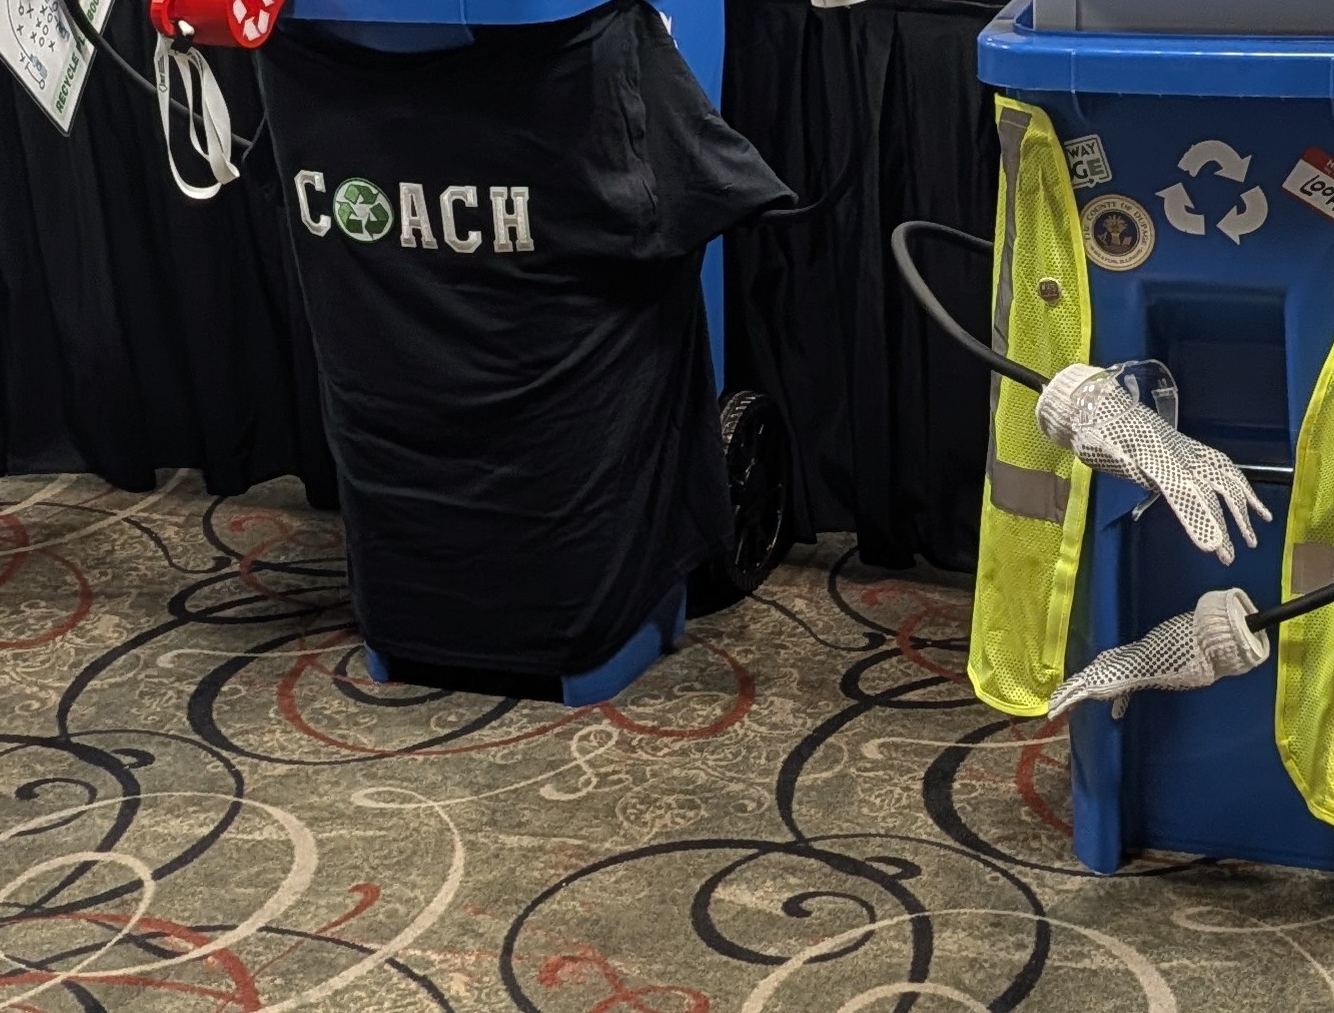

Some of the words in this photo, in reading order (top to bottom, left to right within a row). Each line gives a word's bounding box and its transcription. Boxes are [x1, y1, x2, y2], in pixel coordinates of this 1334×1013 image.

[55, 52, 81, 115] RECYCLE
[1087, 200, 1117, 221] COUNTY
[1120, 201, 1133, 211] OF
[1133, 210, 1148, 247] DUPAGE
